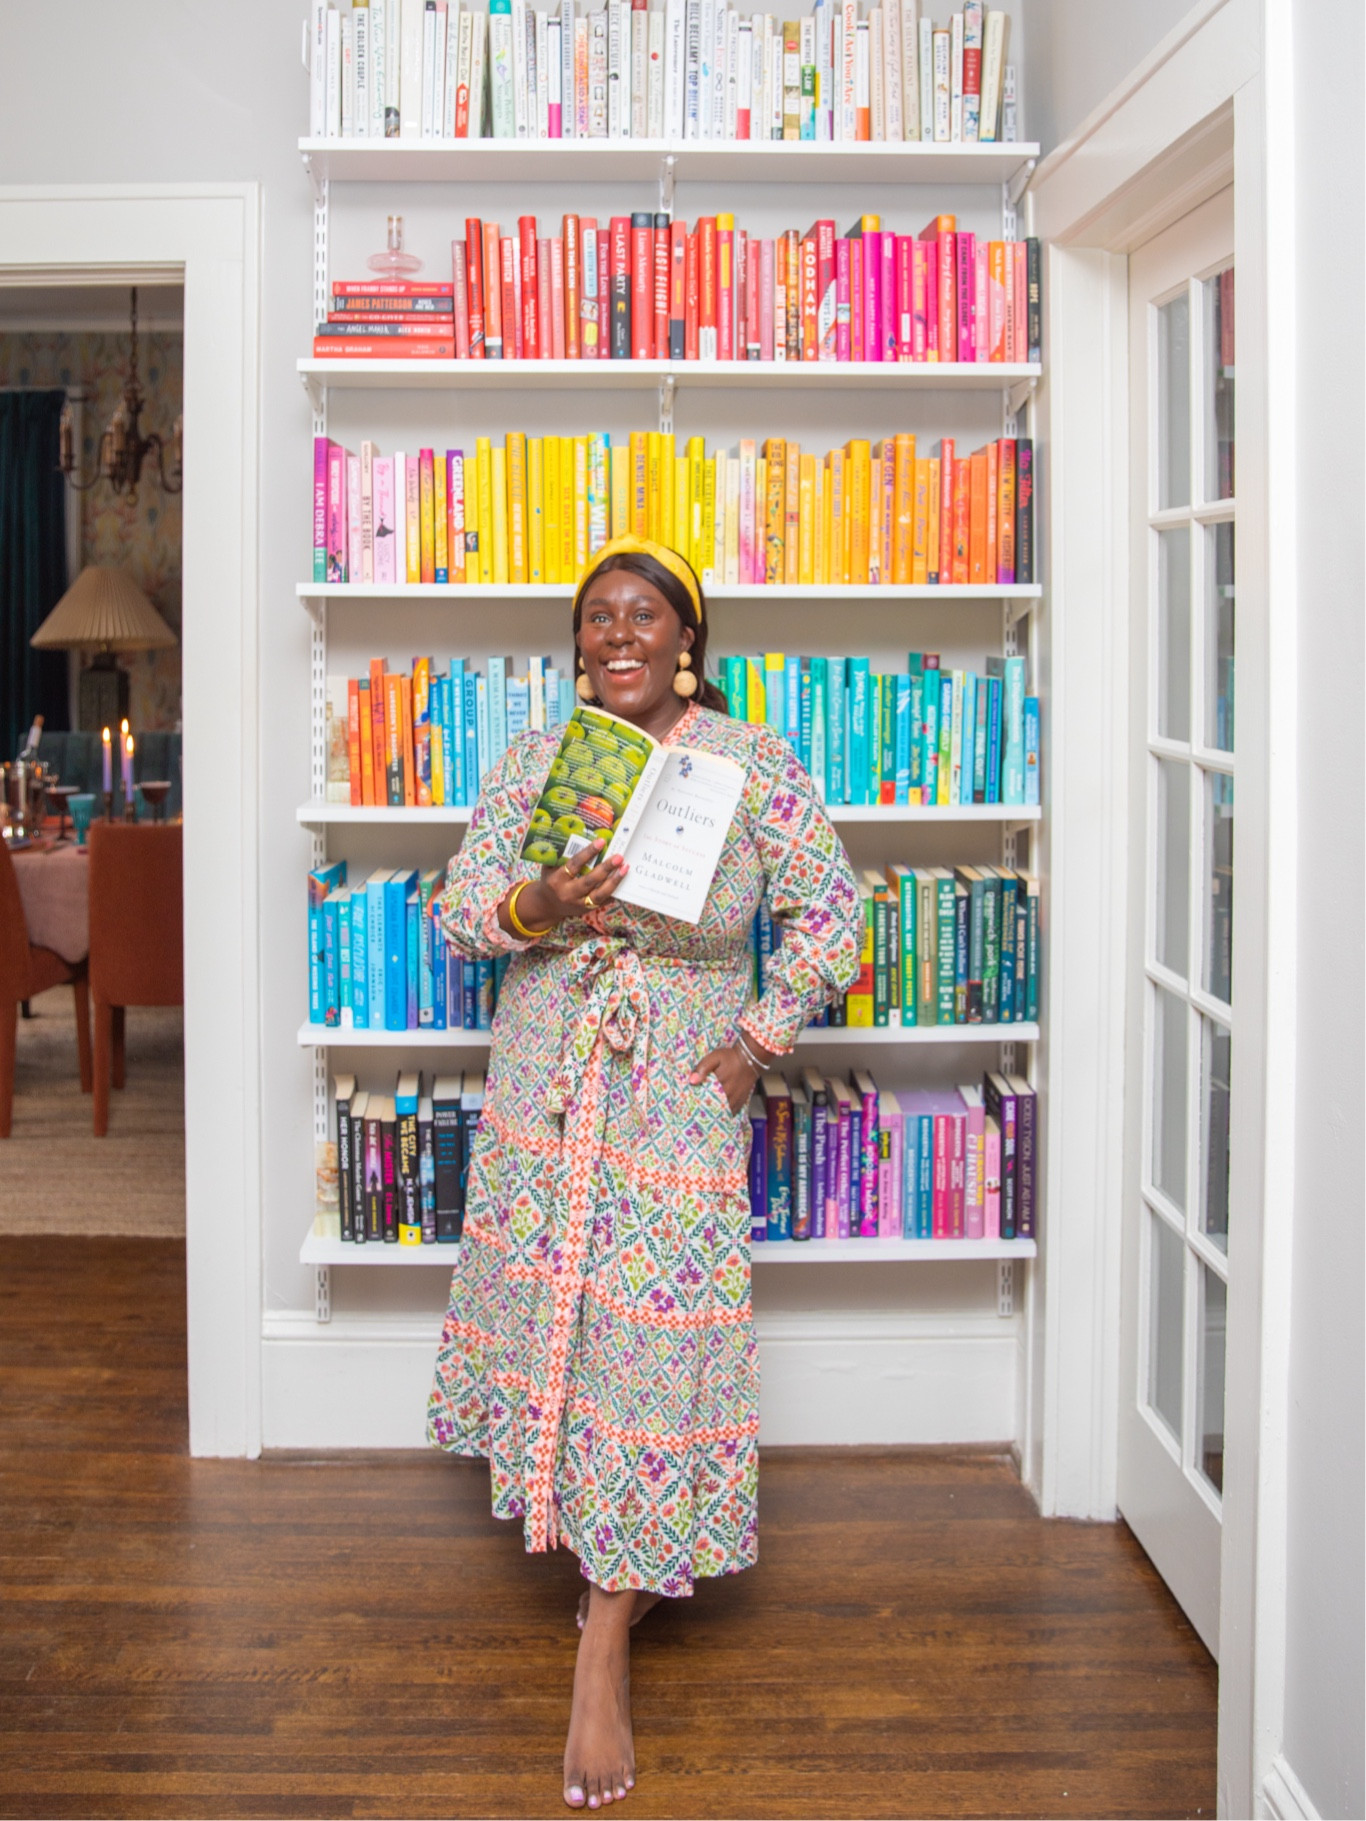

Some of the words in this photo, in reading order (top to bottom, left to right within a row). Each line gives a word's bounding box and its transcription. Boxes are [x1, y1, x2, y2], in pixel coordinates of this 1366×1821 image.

[357, 14, 365, 27] THE
[689, 2, 700, 21] BILL
[845, 4, 855, 32] Cook
[357, 30, 365, 58] GOLDEN
[689, 24, 699, 64] BELLAMY
[845, 39, 854, 53] As
[357, 61, 365, 89] COUPLE
[689, 70, 699, 86] TOP
[845, 59, 854, 81] You
[845, 85, 854, 104] Are
[568, 218, 576, 249] UNDER
[638, 232, 647, 255] Liane
[568, 250, 576, 267] THE
[616, 234, 626, 259] LAST
[655, 243, 667, 272] LAST
[568, 267, 576, 289] SKIN
[616, 262, 626, 295] PARTY
[636, 255, 648, 294] Moriarty
[805, 241, 816, 316] RODHAM
[346, 298, 370, 310] JAMES
[371, 298, 413, 310] PATTERSON
[655, 275, 668, 316] FLIGHT
[884, 443, 895, 463] OUR
[1020, 449, 1032, 469] No
[636, 454, 645, 484] DENISE
[884, 465, 895, 486] GEN
[316, 489, 324, 506] AM
[362, 496, 370, 506] BY
[452, 456, 463, 530] GREENLAND
[636, 486, 645, 510] MINA
[1019, 474, 1032, 509] Filter
[316, 509, 324, 545] DEBRA
[362, 510, 371, 525] THE
[591, 504, 606, 552] WILL
[362, 528, 371, 551] BOOK
[316, 548, 324, 564] LEE
[789, 664, 797, 678] THE
[1012, 666, 1021, 681] The
[466, 679, 474, 726] GROUP
[942, 683, 950, 715] DARING
[1011, 682, 1021, 743] Displacements
[941, 715, 950, 752] GREATLY
[391, 733, 399, 771] DAUGHTER
[976, 759, 984, 776] CUT
[656, 798, 716, 829] Outliers
[641, 851, 694, 877] MALCOLM
[635, 864, 692, 892] GLADWELL
[985, 891, 997, 941] greenwich
[761, 938, 770, 950] TO
[904, 933, 912, 950] BABY
[985, 944, 996, 967] park
[904, 981, 913, 1006] PETERS
[815, 1110, 826, 1133] The
[1005, 1101, 1015, 1121] SCARE
[1022, 1097, 1033, 1128] CICELY
[401, 1121, 408, 1135] WE
[1006, 1121, 1014, 1138] YOUR
[798, 1133, 807, 1153] THIS
[815, 1135, 826, 1165] Push
[1006, 1138, 1015, 1155] SOUL
[1022, 1130, 1032, 1160] TYSON
[384, 1151, 393, 1184] MISTER
[798, 1163, 807, 1178] MY
[966, 1153, 977, 1206] HAUSER
[1022, 1163, 1032, 1185] JUST
[798, 1179, 808, 1218] AMERICA
[816, 1181, 825, 1205] Ashley
[866, 1189, 874, 1220] MAGIC
[1023, 1187, 1032, 1200] AS
[1023, 1205, 1032, 1220] AM
